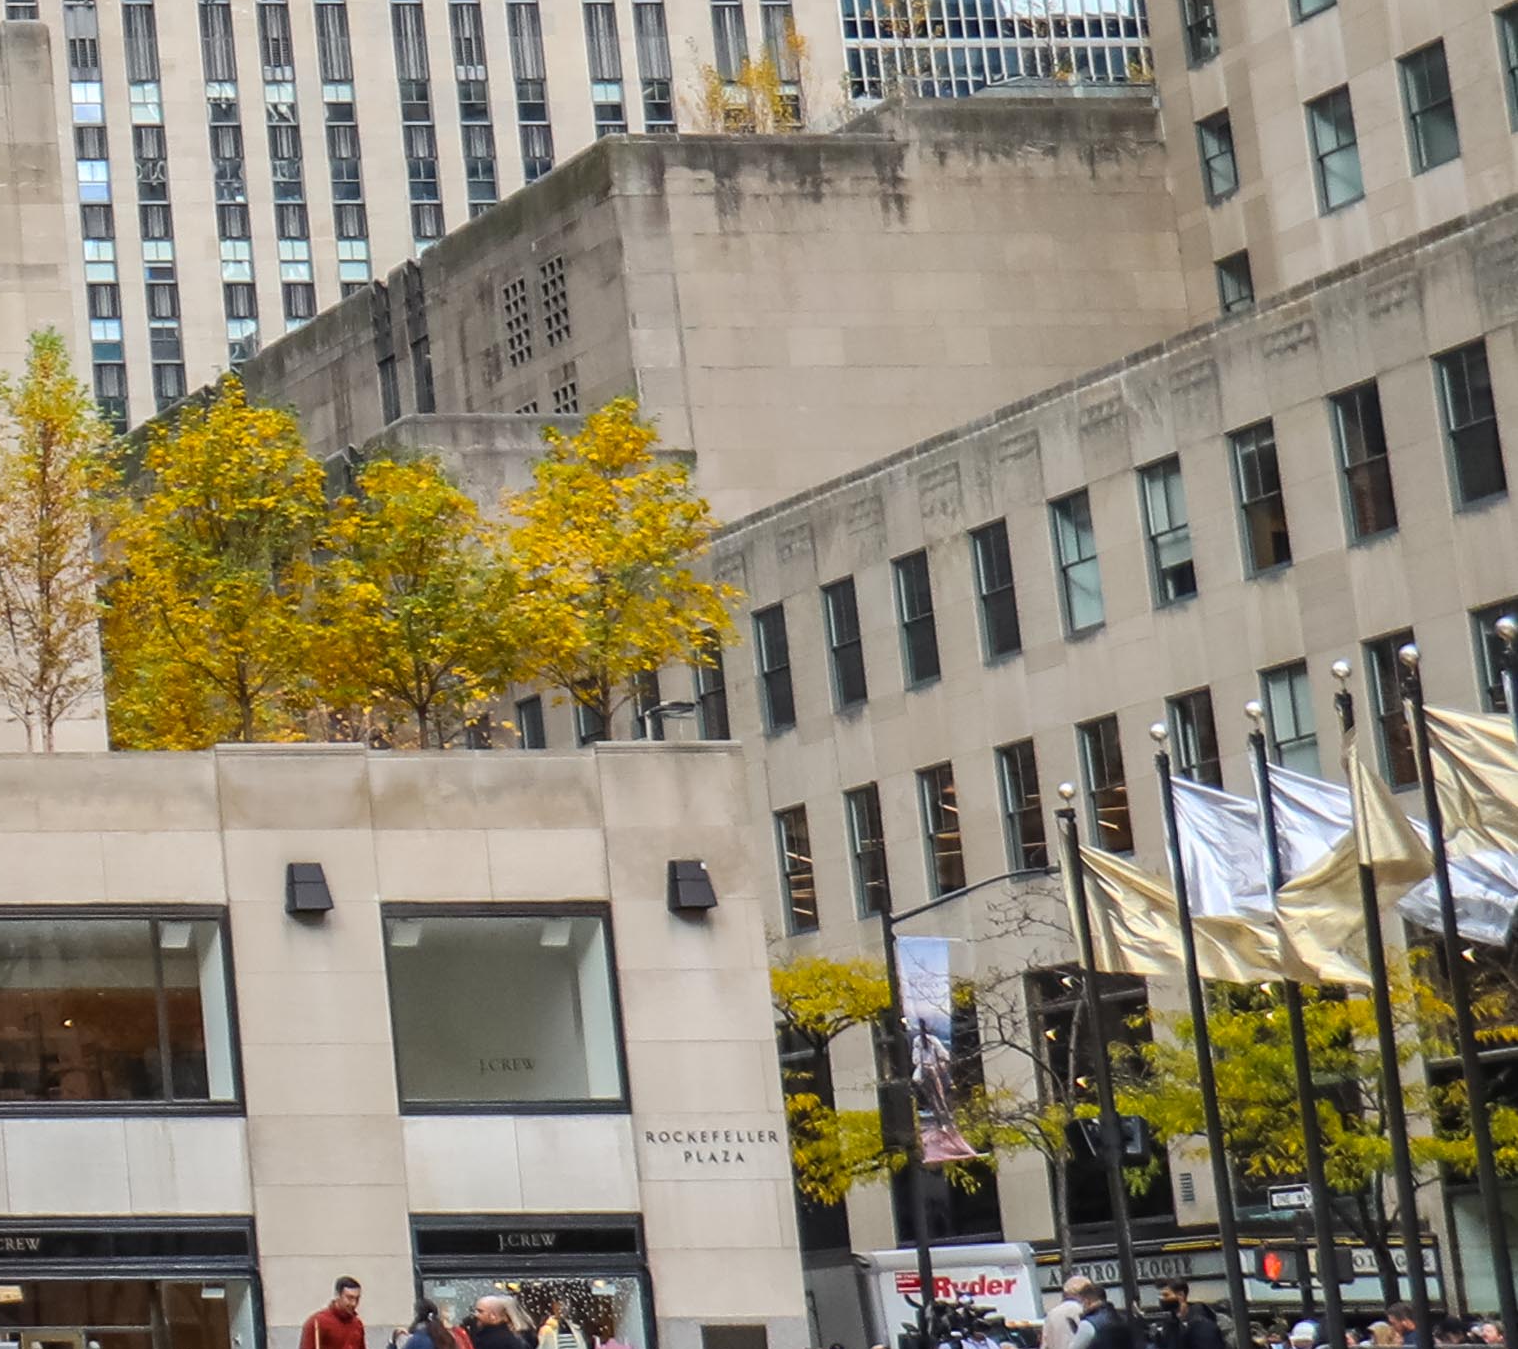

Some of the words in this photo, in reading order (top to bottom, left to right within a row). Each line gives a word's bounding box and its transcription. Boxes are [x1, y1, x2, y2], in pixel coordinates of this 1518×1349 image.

[479, 1058, 536, 1076] J.CREW
[646, 1130, 779, 1143] ROCKEFELLER
[684, 1150, 745, 1163] PLAZA
[498, 1233, 557, 1253] J.CREW
